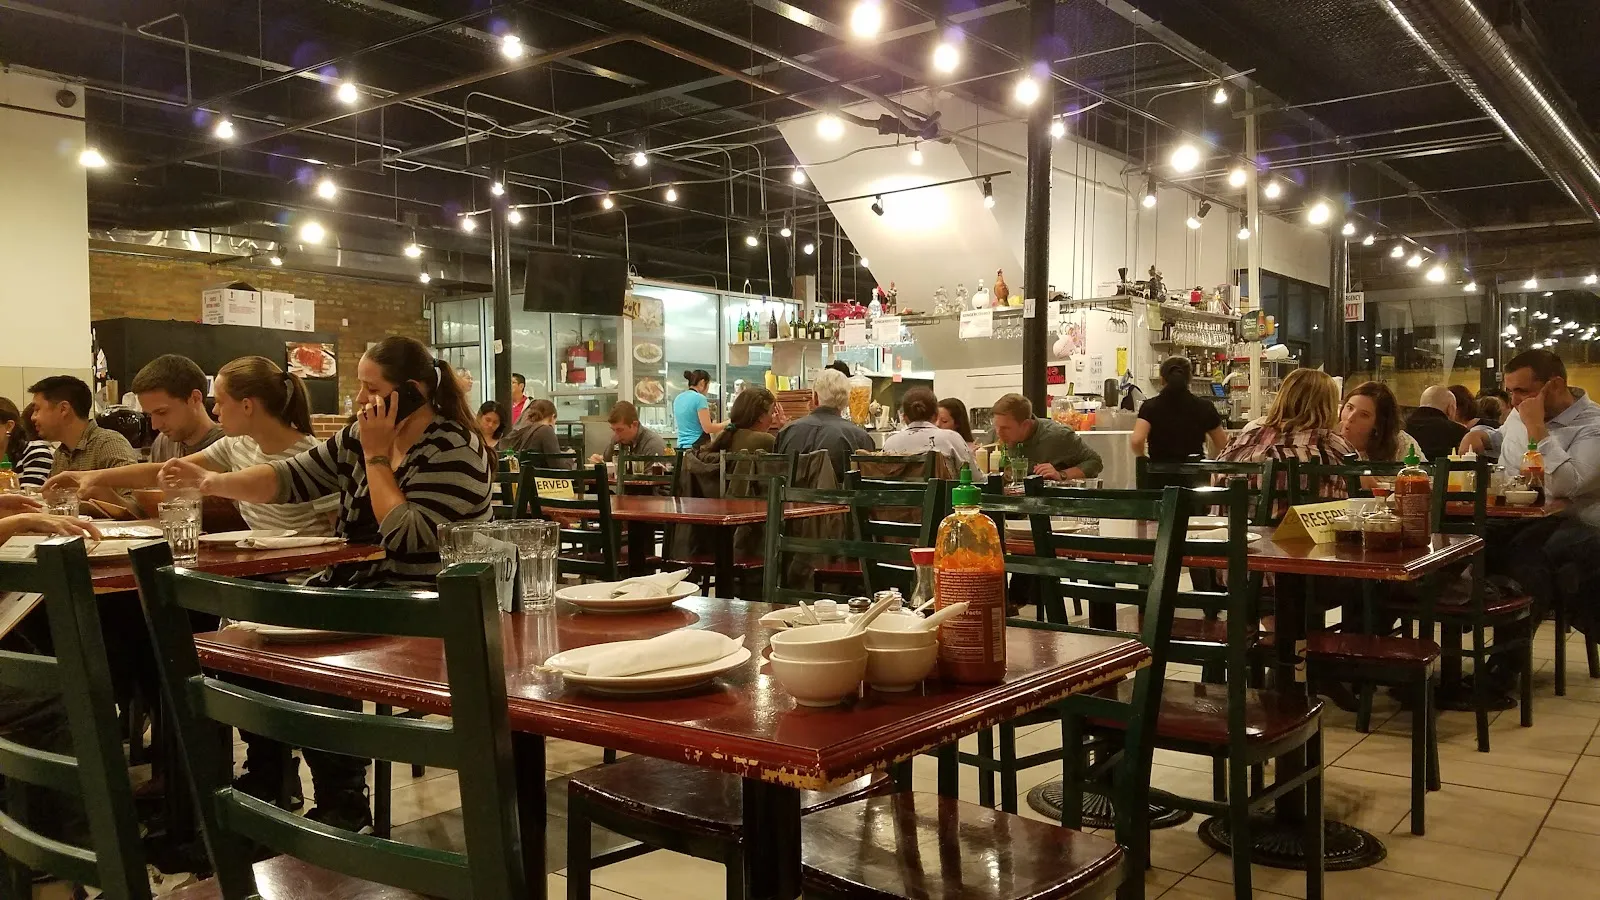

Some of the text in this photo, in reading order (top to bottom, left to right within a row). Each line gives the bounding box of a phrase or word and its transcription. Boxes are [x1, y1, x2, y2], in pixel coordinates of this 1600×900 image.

[1345, 303, 1359, 317] XIT
[536, 480, 569, 490] ERVED
[1299, 508, 1346, 528] RESERV
